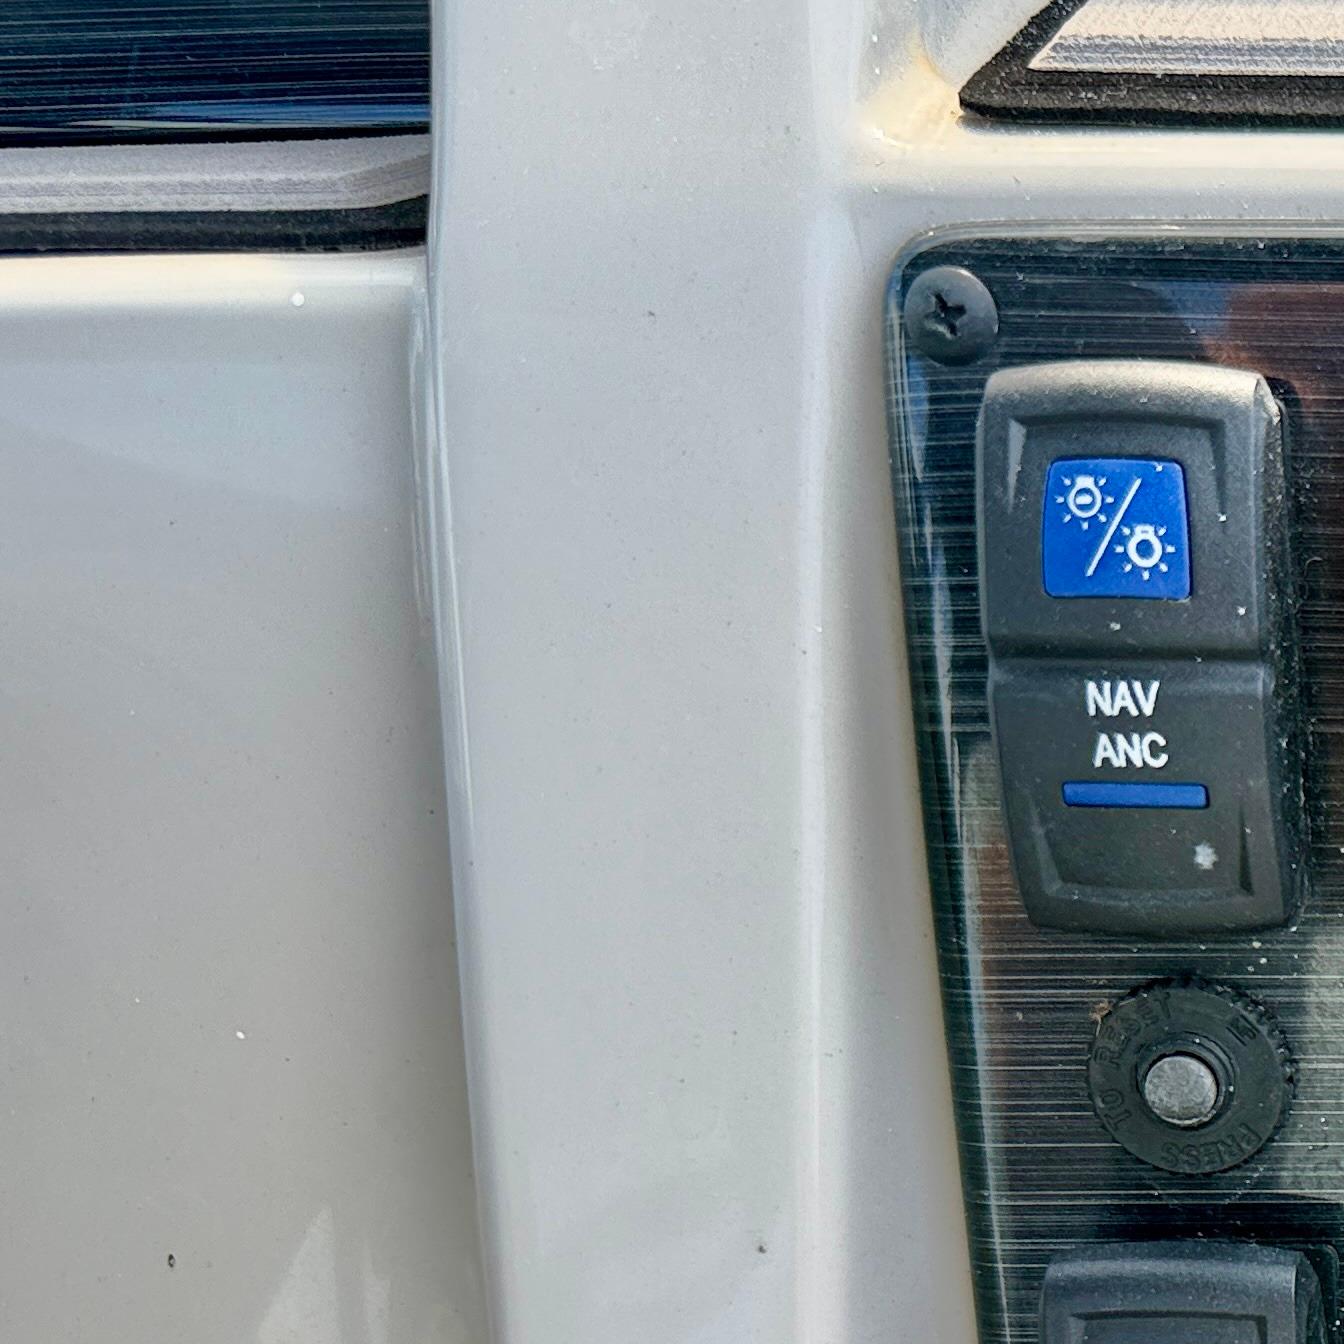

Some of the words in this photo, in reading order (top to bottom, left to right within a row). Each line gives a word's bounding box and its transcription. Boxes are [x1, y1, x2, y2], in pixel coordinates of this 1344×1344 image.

[1086, 680, 1160, 717] NAV
[1093, 731, 1169, 769] ANC
[1102, 1088, 1132, 1131] TO
